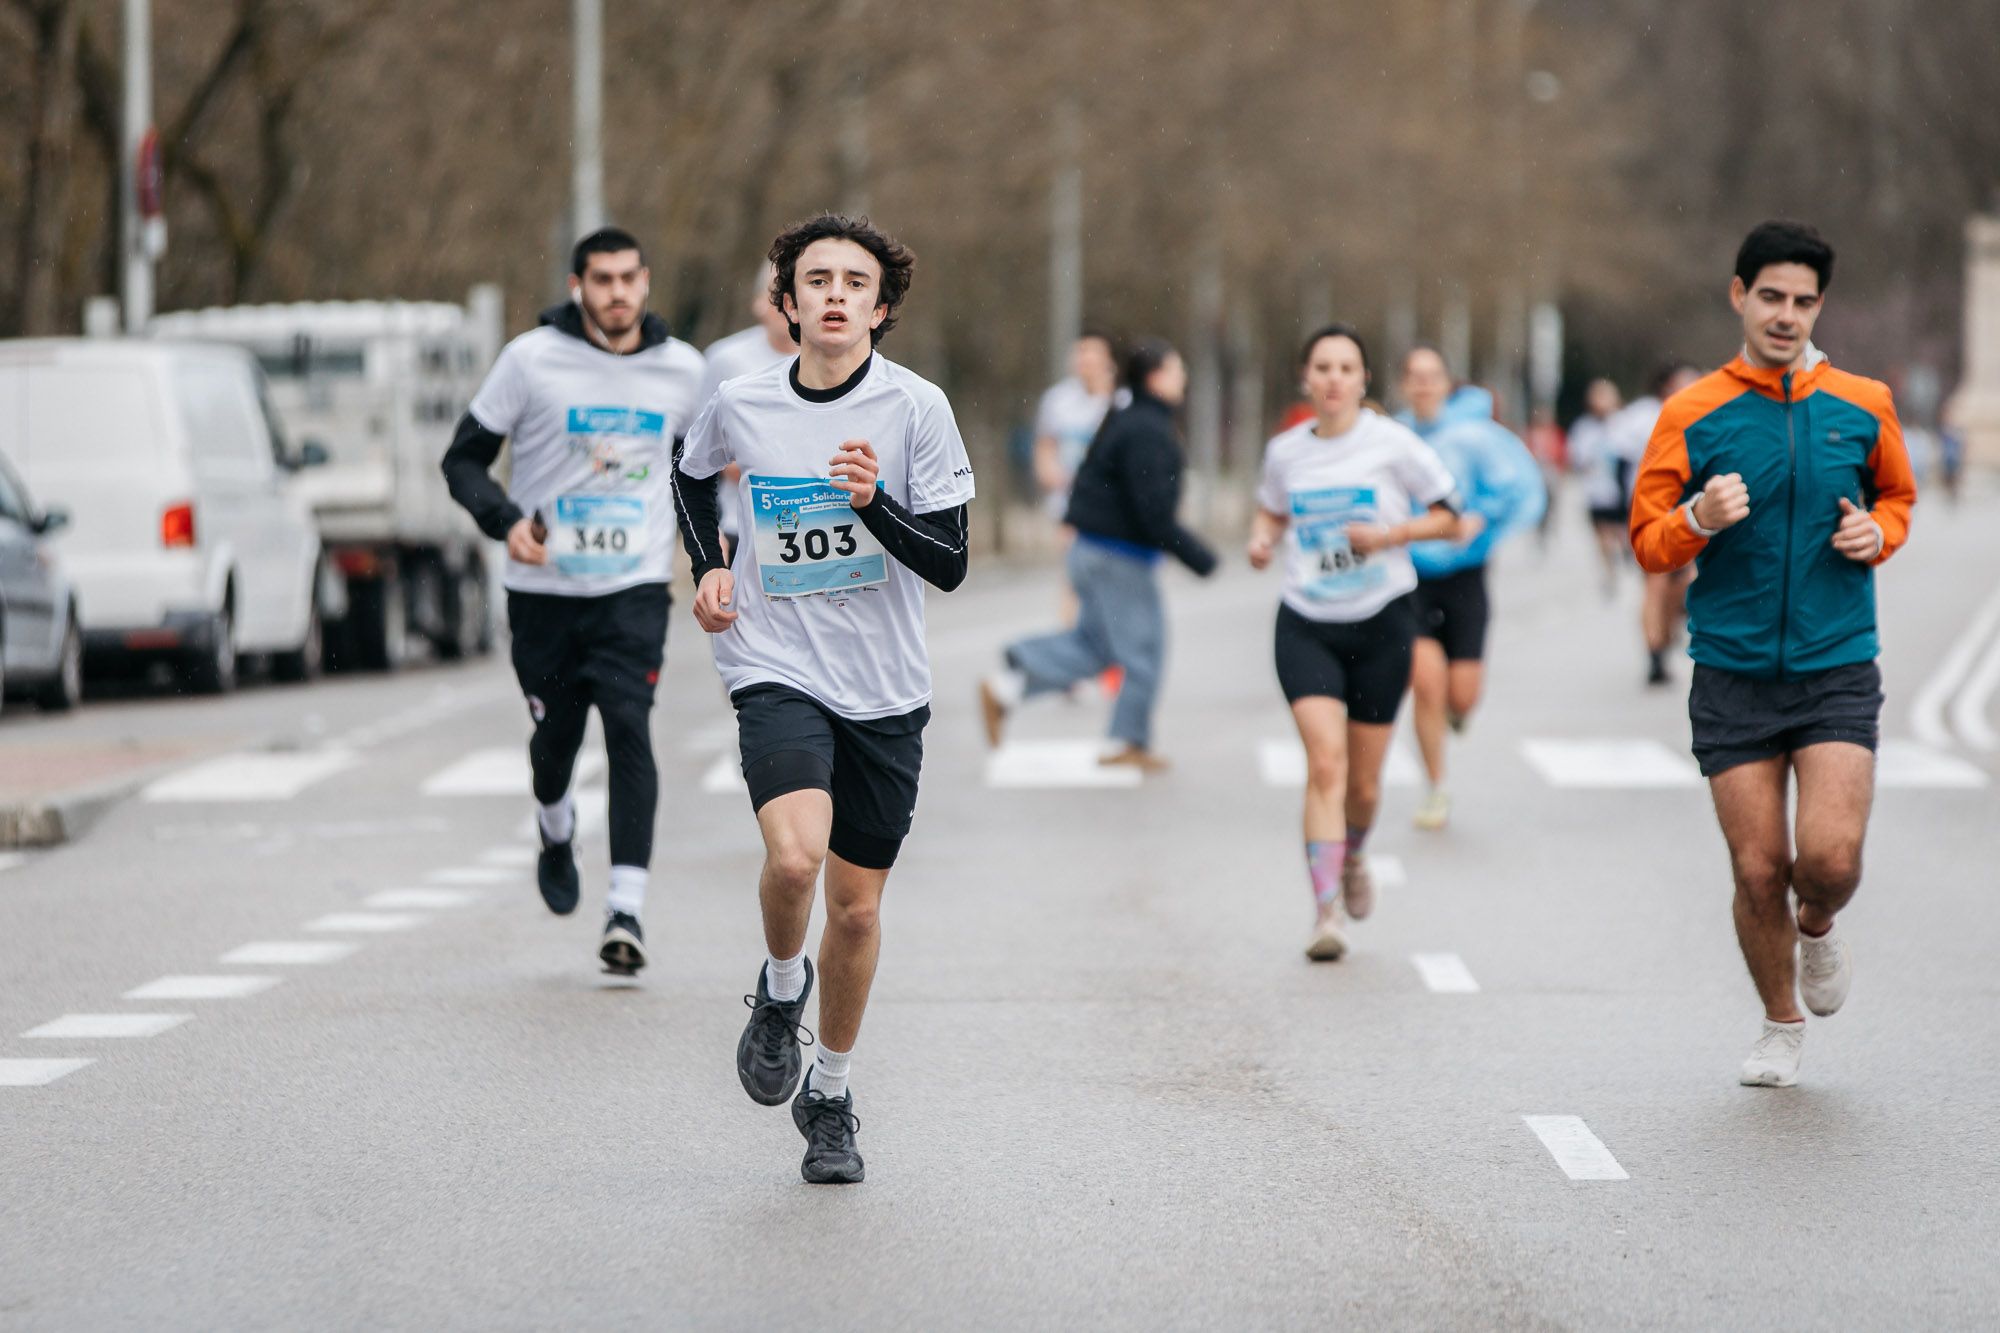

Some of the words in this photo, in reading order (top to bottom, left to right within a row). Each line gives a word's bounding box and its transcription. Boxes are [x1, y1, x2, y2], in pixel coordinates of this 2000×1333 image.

[774, 497, 810, 506] Carrera
[575, 528, 627, 550] 340
[778, 523, 857, 563] 303
